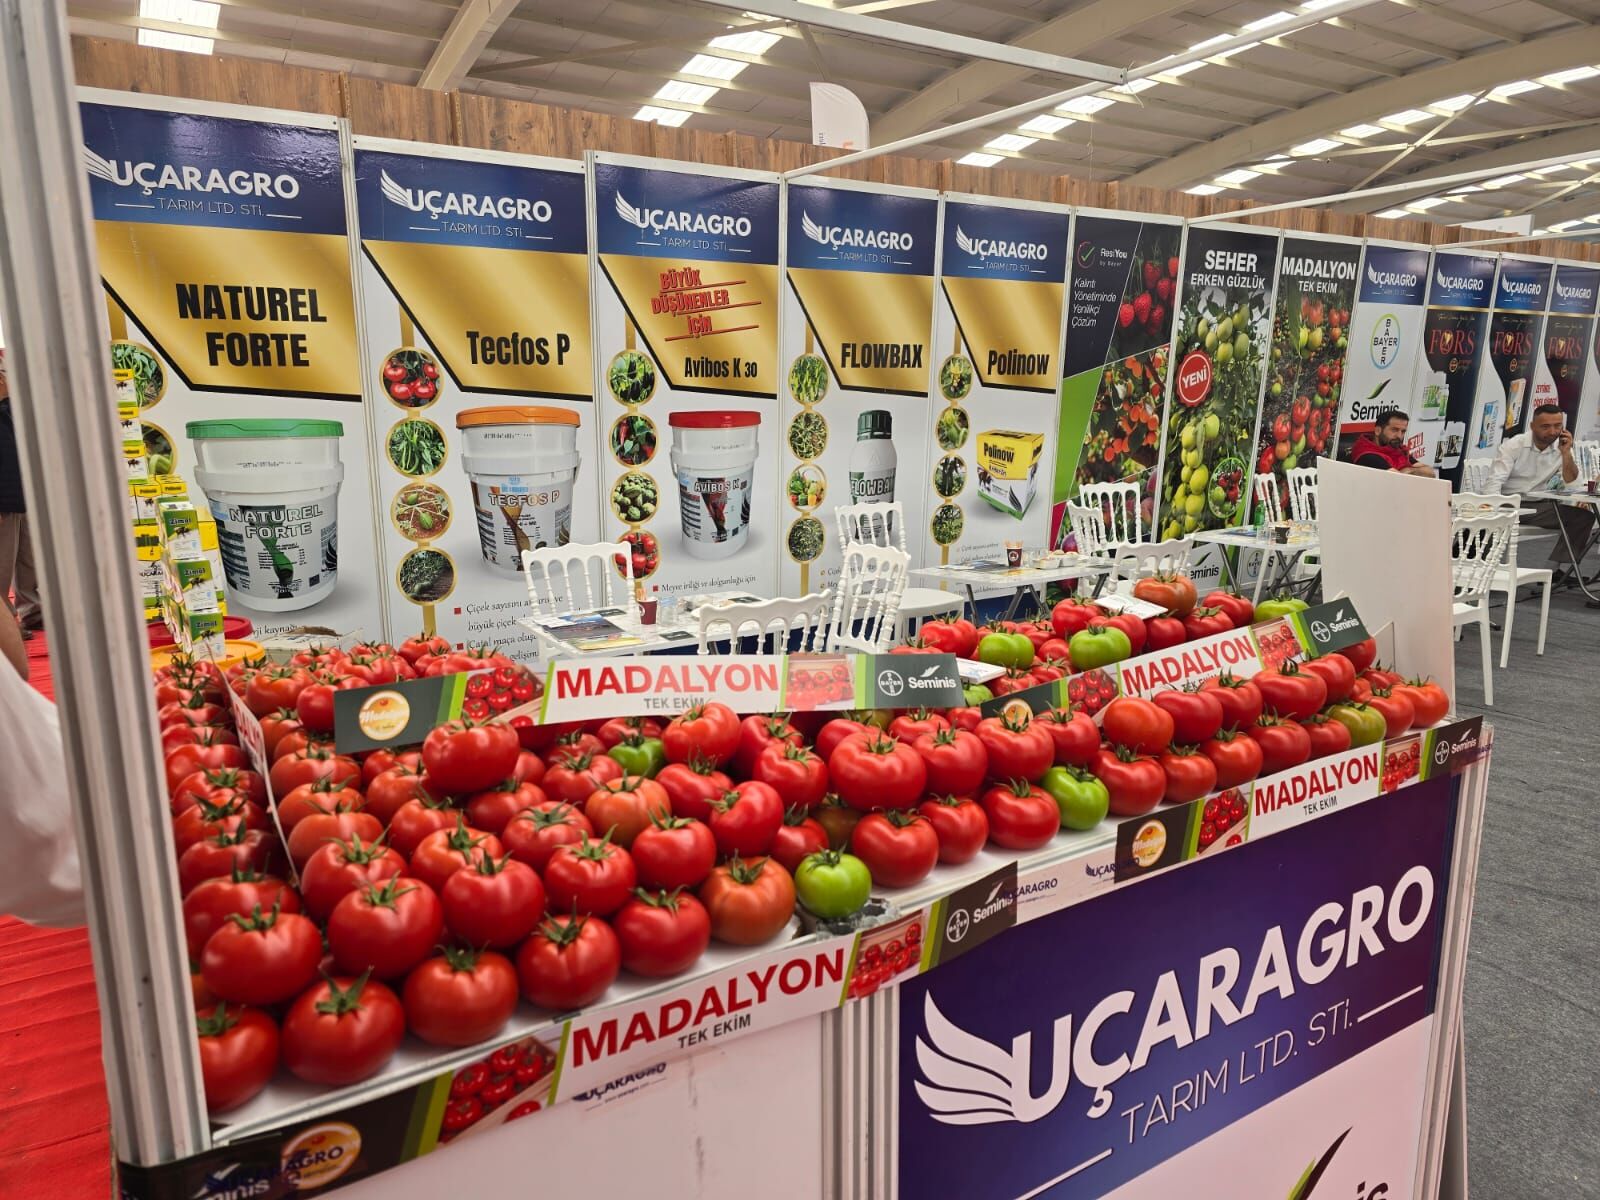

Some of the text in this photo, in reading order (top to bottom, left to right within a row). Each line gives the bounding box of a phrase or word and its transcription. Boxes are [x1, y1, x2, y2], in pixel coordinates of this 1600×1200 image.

[111, 159, 300, 200] UÇARAGRO
[156, 197, 204, 212] TARIM
[208, 201, 237, 215] LTD.
[408, 188, 552, 223] UÇARAGRO
[442, 220, 478, 235] TARIM
[637, 207, 752, 238] UÇARAGRO
[662, 237, 691, 249] TARIM
[817, 226, 913, 251] UÇARAGRO
[969, 239, 1048, 261] UÇARAGRO
[1205, 249, 1258, 273] SEHER
[659, 266, 702, 291] BÜYÜK
[1281, 256, 1357, 281] MADALYON
[1374, 270, 1417, 289] UÇARAGRO
[1190, 273, 1266, 290] ERKEN GÜZLÜK
[1298, 280, 1338, 294] TEK EKİM
[1443, 276, 1484, 292] UÇARAGRO
[1506, 281, 1542, 297] UÇARAGRO
[176, 283, 328, 323] NATUREL
[651, 290, 730, 317] DÜŞÜNENLER
[1561, 286, 1592, 301] UÇARAGRO
[688, 314, 713, 339] İÇİN
[1071, 316, 1097, 329] Çözüm
[205, 331, 310, 368] FORTE
[466, 330, 570, 366] Tecfos P
[1373, 337, 1398, 347] BAYER
[1428, 329, 1476, 355] FORS
[1493, 331, 1535, 356] FORS
[840, 342, 923, 369] FLOWBAX
[987, 348, 1050, 377] Polinow
[684, 357, 758, 379] Avibos K 30
[1182, 365, 1209, 390] YENİ
[983, 442, 1015, 464] Polinow
[488, 490, 560, 507] TECFOS P
[228, 503, 325, 523] NATUREL
[245, 521, 313, 539] FORTE
[1190, 564, 1219, 580] eminis
[661, 583, 682, 594] Meyve
[466, 602, 490, 615] Çiçek
[492, 601, 522, 611] sayısını
[468, 615, 517, 633] büyük çiçek
[1329, 617, 1360, 634] Seminis
[494, 635, 515, 647] maça
[1121, 635, 1257, 696] MADALYON
[556, 663, 779, 700] MADALYON
[908, 676, 957, 689] Seminis
[644, 696, 671, 710] TEK
[1451, 737, 1477, 754] Seminis
[1254, 752, 1378, 817] MADALYON
[1303, 795, 1338, 817] TEK EKİM
[1012, 864, 1435, 1122] UÇARAGRO
[572, 947, 846, 1069] MADALYON
[678, 1013, 752, 1050] TEK EKİM
[1120, 1058, 1229, 1146] TARIM
[1239, 1034, 1297, 1088] LTD.
